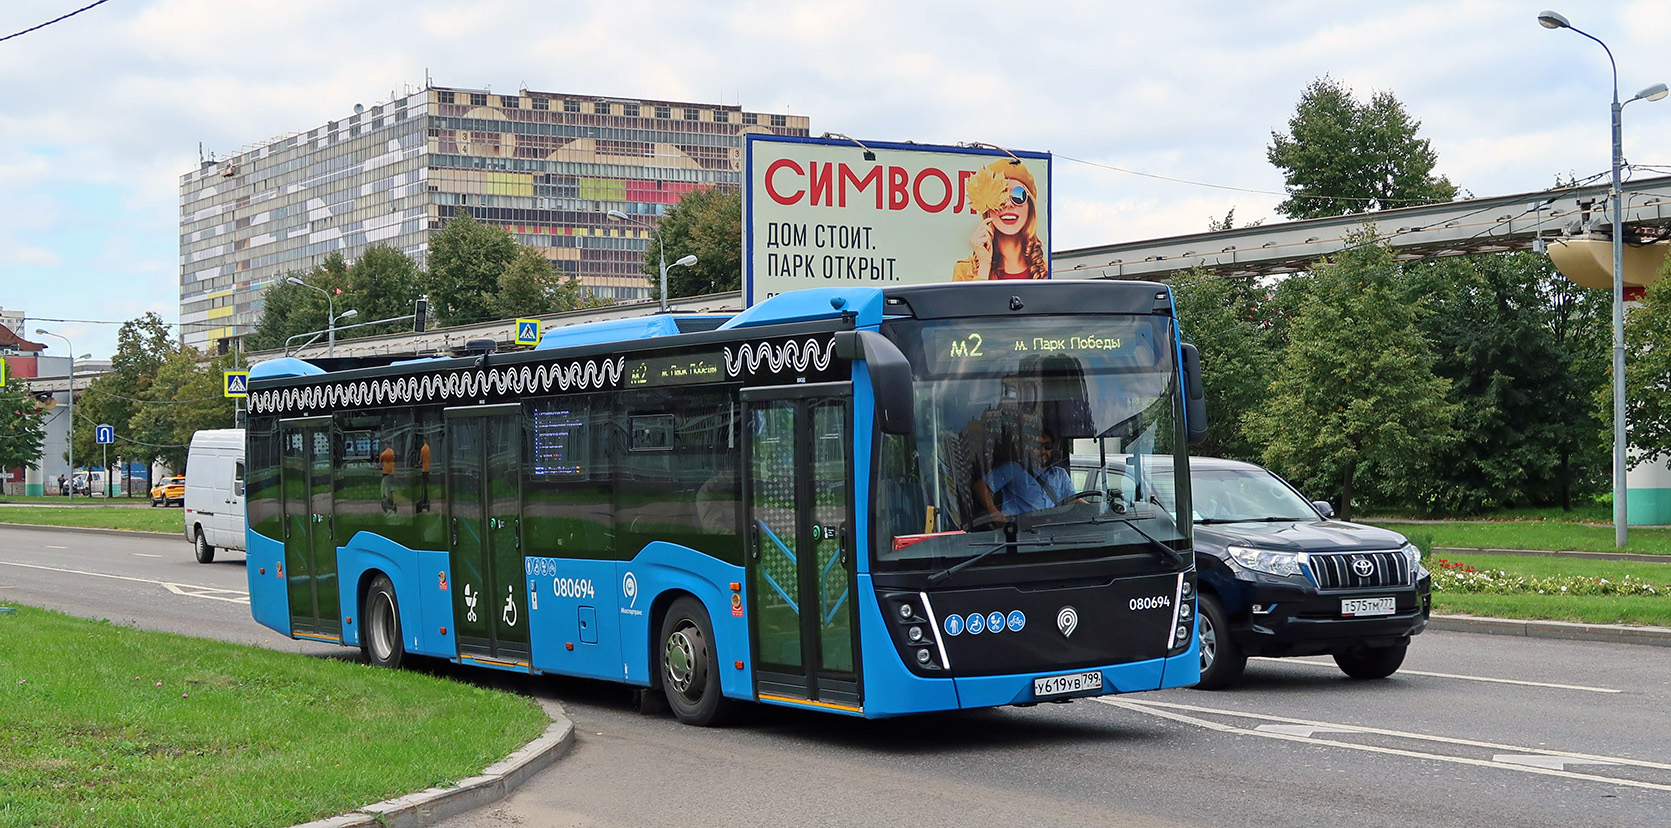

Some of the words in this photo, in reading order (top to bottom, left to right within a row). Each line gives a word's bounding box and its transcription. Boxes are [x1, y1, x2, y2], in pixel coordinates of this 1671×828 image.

[764, 158, 977, 215] СИМВОЛ
[766, 222, 807, 249] ДОМ
[815, 224, 877, 250] СТОИТ.
[767, 253, 815, 278] ПАРК
[822, 255, 900, 281] ОТКРЫТ.
[1033, 337, 1066, 352] Парк
[1070, 334, 1121, 351] Победы
[553, 577, 595, 599] 080694
[1129, 595, 1170, 611] 080694
[1379, 598, 1393, 608] 777
[1082, 672, 1099, 685] 799
